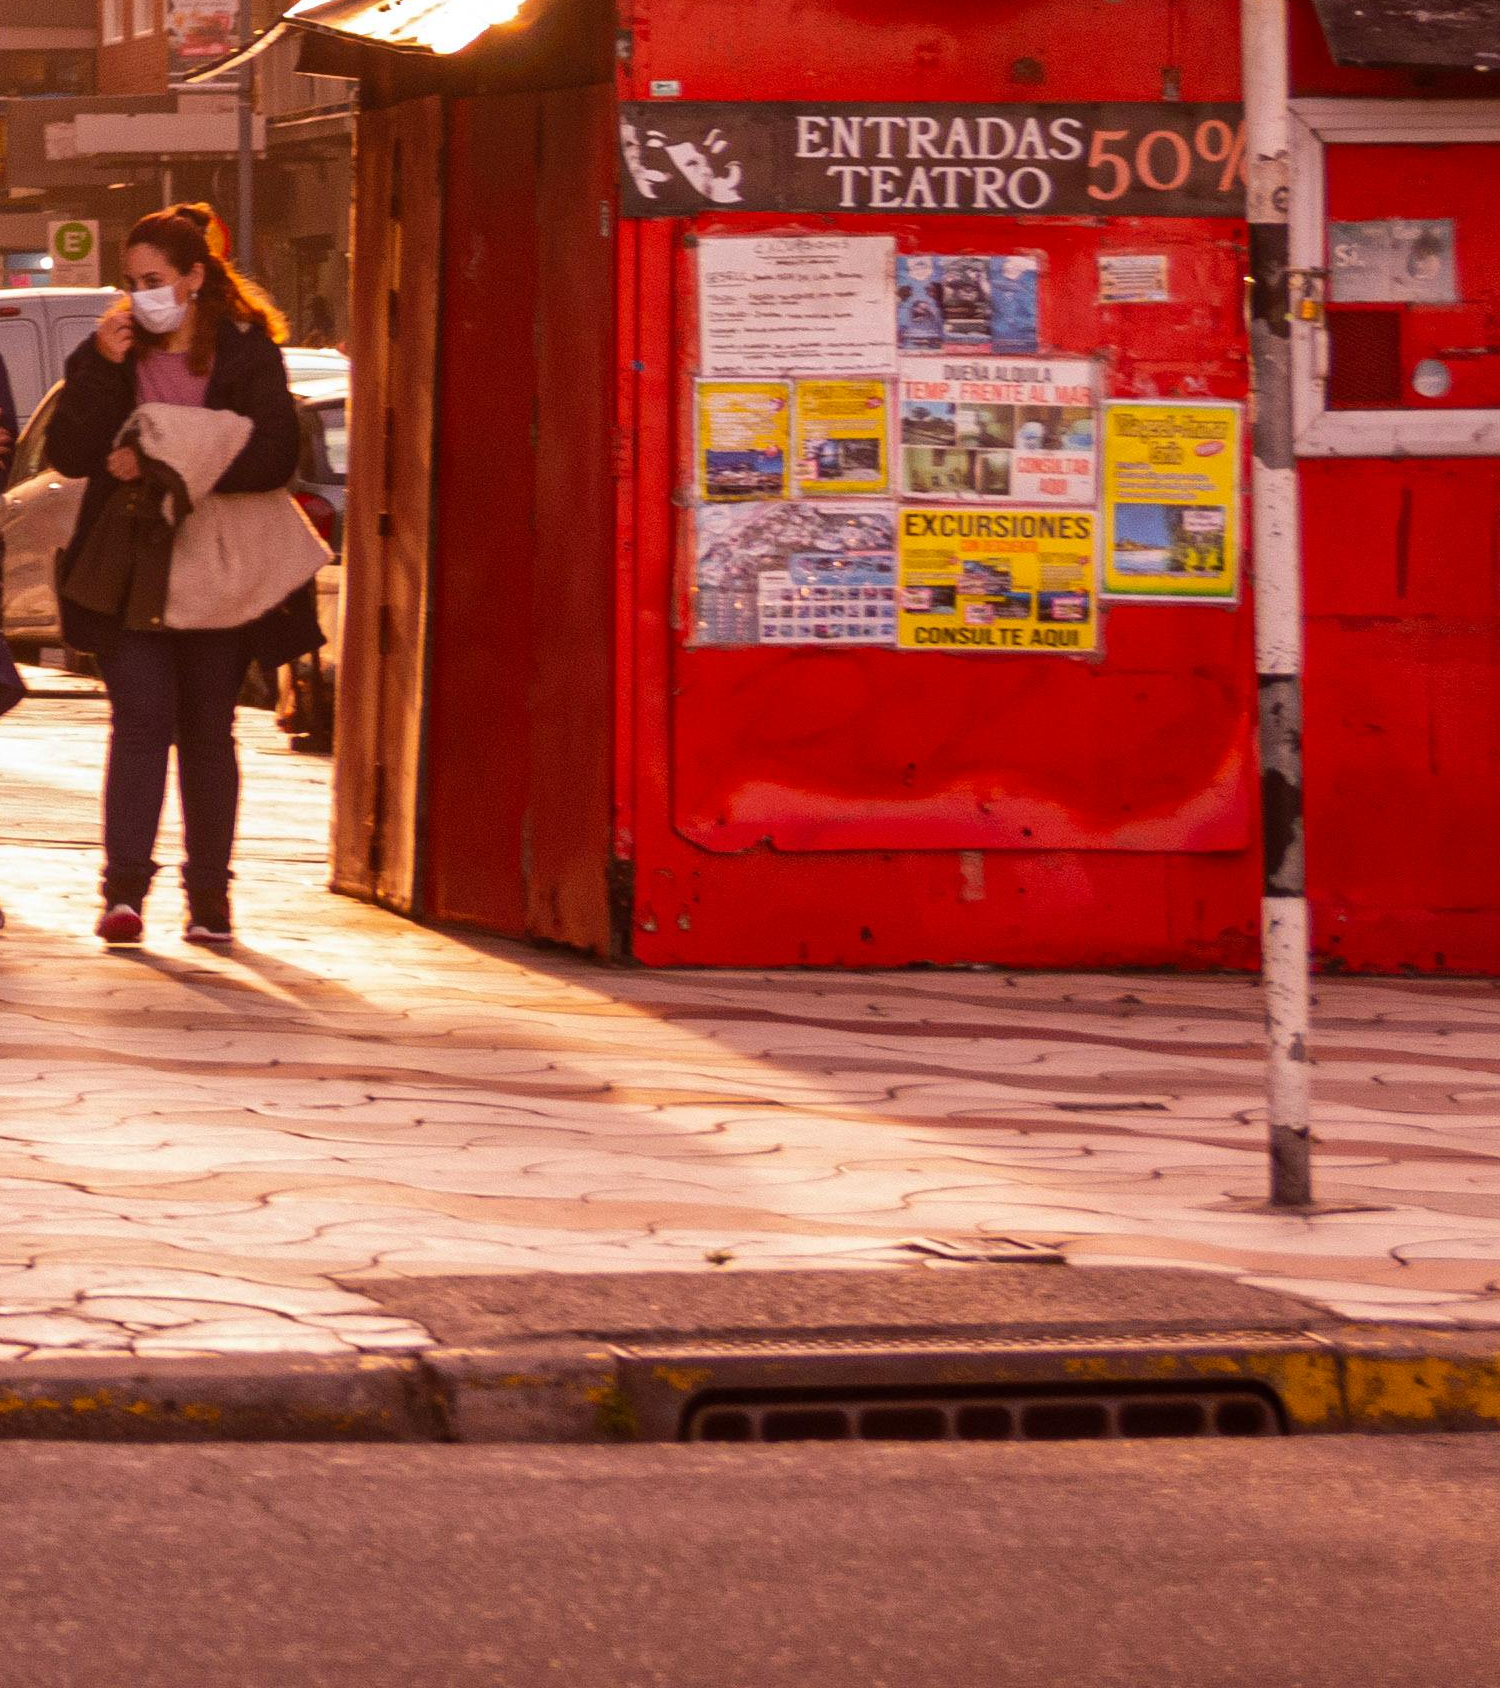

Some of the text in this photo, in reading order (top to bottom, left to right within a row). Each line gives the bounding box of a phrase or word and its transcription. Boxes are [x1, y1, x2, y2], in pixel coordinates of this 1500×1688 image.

[796, 115, 1084, 161] ENTRADAS
[826, 165, 1052, 210] TEATRO
[904, 513, 1091, 540] EXCURSIONES
[915, 626, 1080, 647] CONSULTE AQUI
